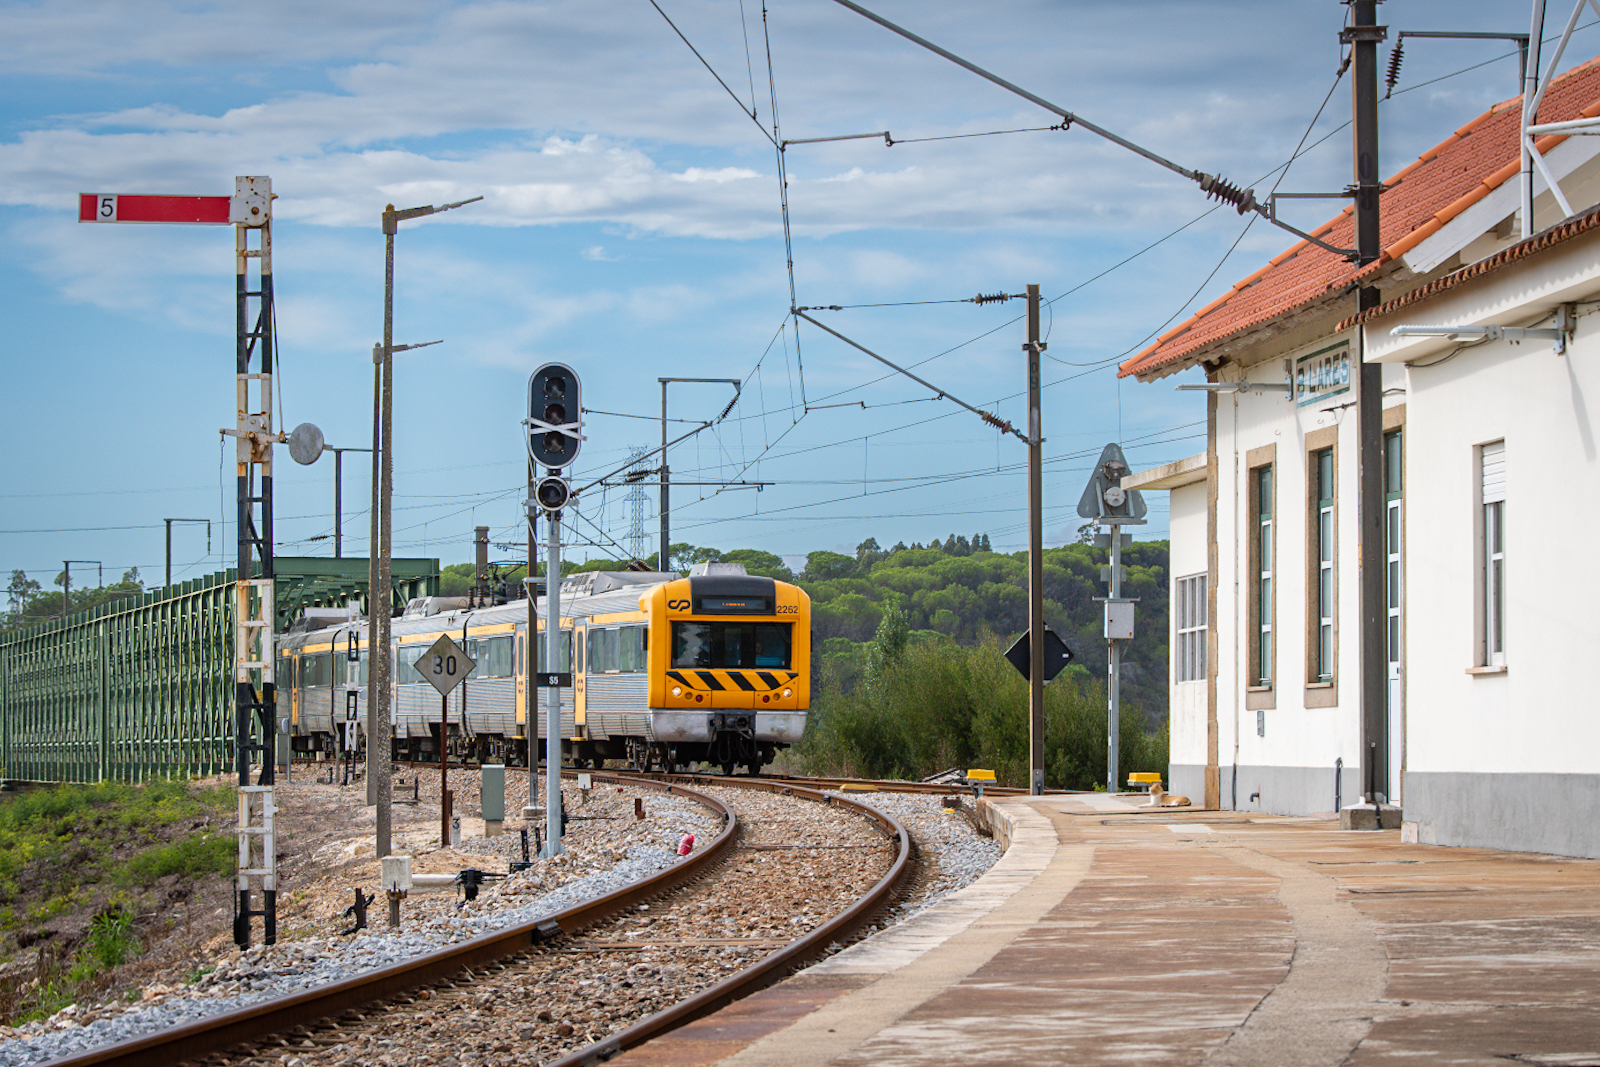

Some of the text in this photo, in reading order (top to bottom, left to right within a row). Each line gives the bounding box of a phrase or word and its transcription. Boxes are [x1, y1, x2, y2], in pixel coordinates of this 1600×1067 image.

[100, 198, 114, 217] 5
[668, 600, 690, 612] CP
[776, 605, 799, 614] 2262
[433, 655, 457, 676] 30
[548, 675, 559, 685] S5
[452, 818, 460, 829] 3
